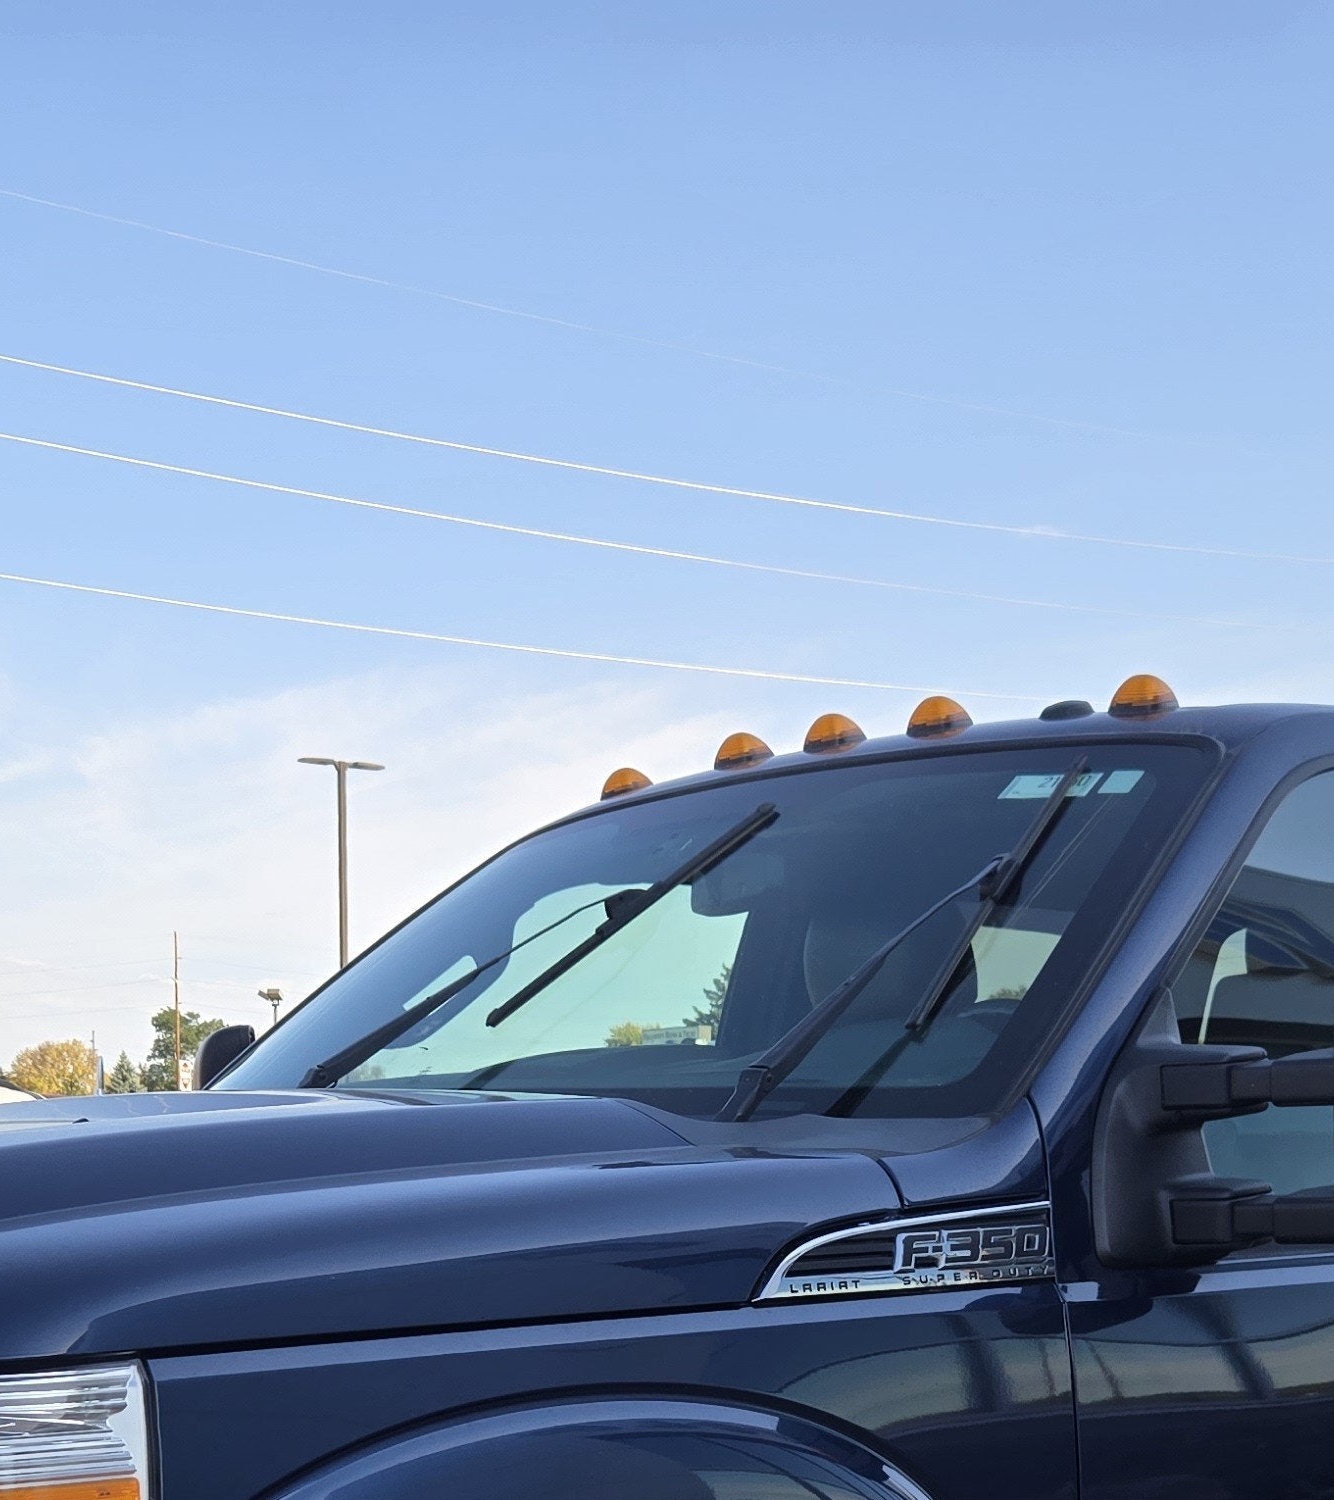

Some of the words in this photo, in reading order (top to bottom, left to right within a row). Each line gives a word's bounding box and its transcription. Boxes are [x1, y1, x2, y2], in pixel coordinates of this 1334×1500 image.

[789, 1279, 861, 1294] LARIAT
[902, 1270, 979, 1286] SUPER
[992, 1263, 1051, 1279] DUTY
